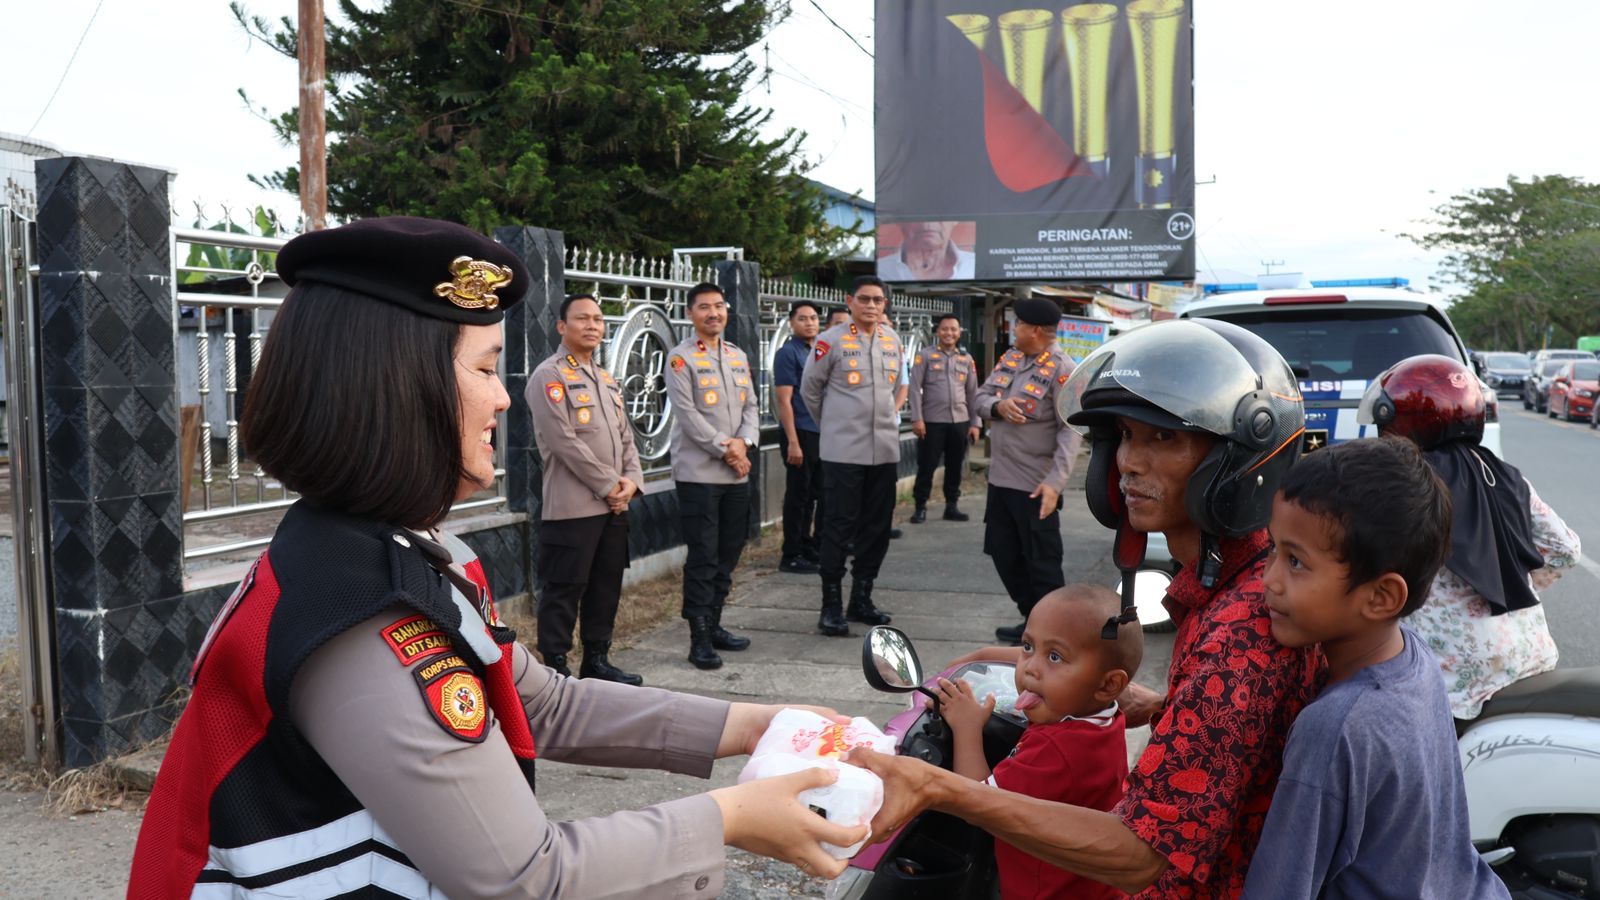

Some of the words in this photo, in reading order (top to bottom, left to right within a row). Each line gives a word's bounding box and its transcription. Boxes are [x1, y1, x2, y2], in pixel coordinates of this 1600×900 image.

[1171, 220, 1191, 232] 21+
[1038, 228, 1133, 242] PERINGATAN:
[989, 247, 1016, 255] KARENA
[1070, 245, 1100, 253] TERKENA
[1084, 261, 1115, 269] MEMBERI
[1143, 260, 1168, 268] ORANG
[1099, 369, 1141, 379] HONDA
[1299, 381, 1341, 392] LISI
[404, 639, 426, 657] DIT
[420, 660, 449, 681] KORPS
